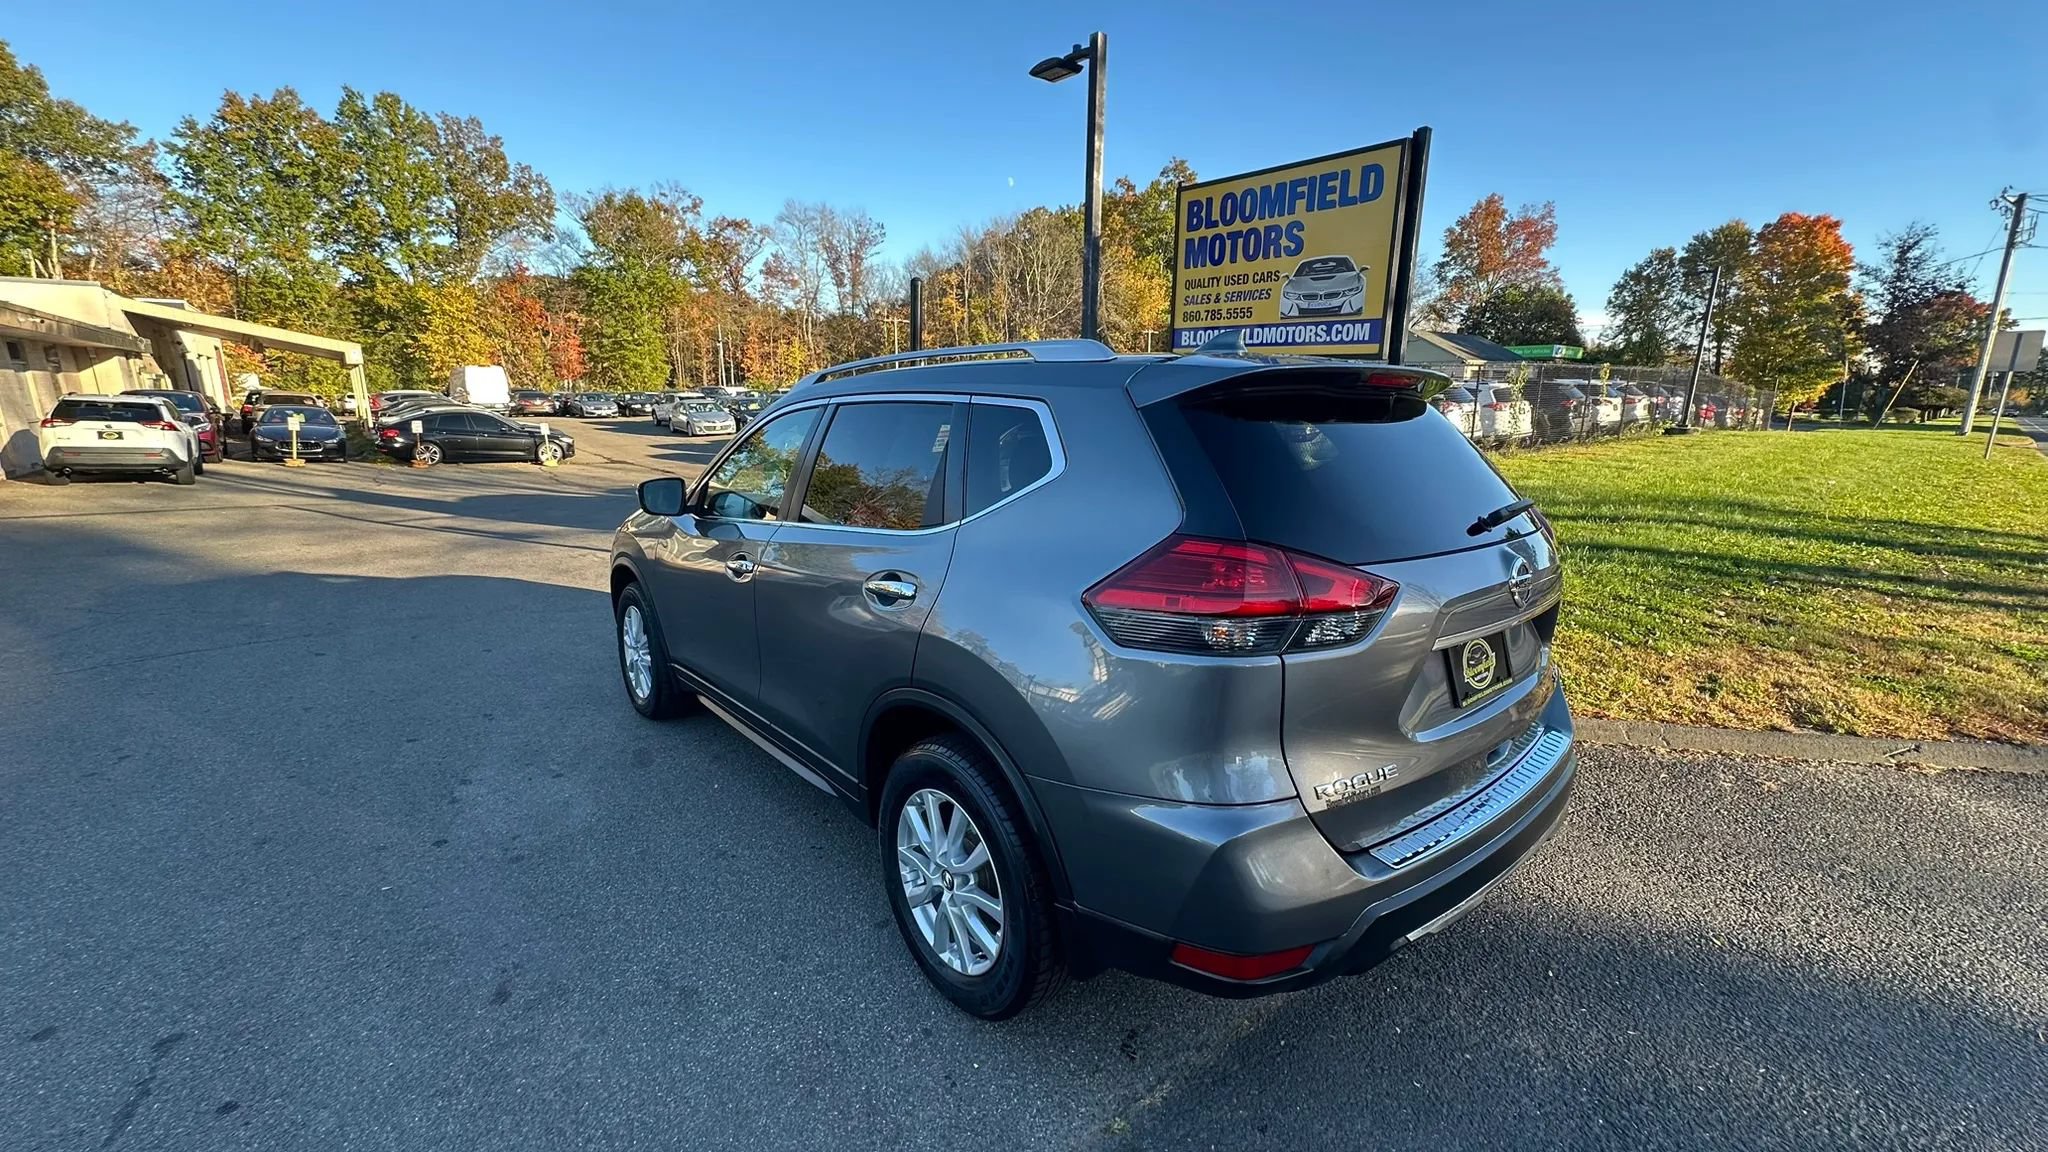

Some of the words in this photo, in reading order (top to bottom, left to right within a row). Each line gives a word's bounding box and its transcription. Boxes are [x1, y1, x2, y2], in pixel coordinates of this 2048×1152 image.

[1186, 163, 1385, 232] BLOOMFIELD
[1184, 221, 1305, 269] MOTORS
[1184, 276, 1222, 291] QUALITY
[1224, 273, 1249, 287] USED
[1252, 270, 1280, 284] CARS
[1183, 293, 1212, 306] SALES
[1213, 292, 1221, 304] &
[1223, 288, 1272, 303] SERVICES
[1182, 306, 1253, 323] 860.785.5555
[1181, 322, 1370, 347] BLOOLDMOTORS.COM
[1313, 763, 1399, 800] ROGUE
